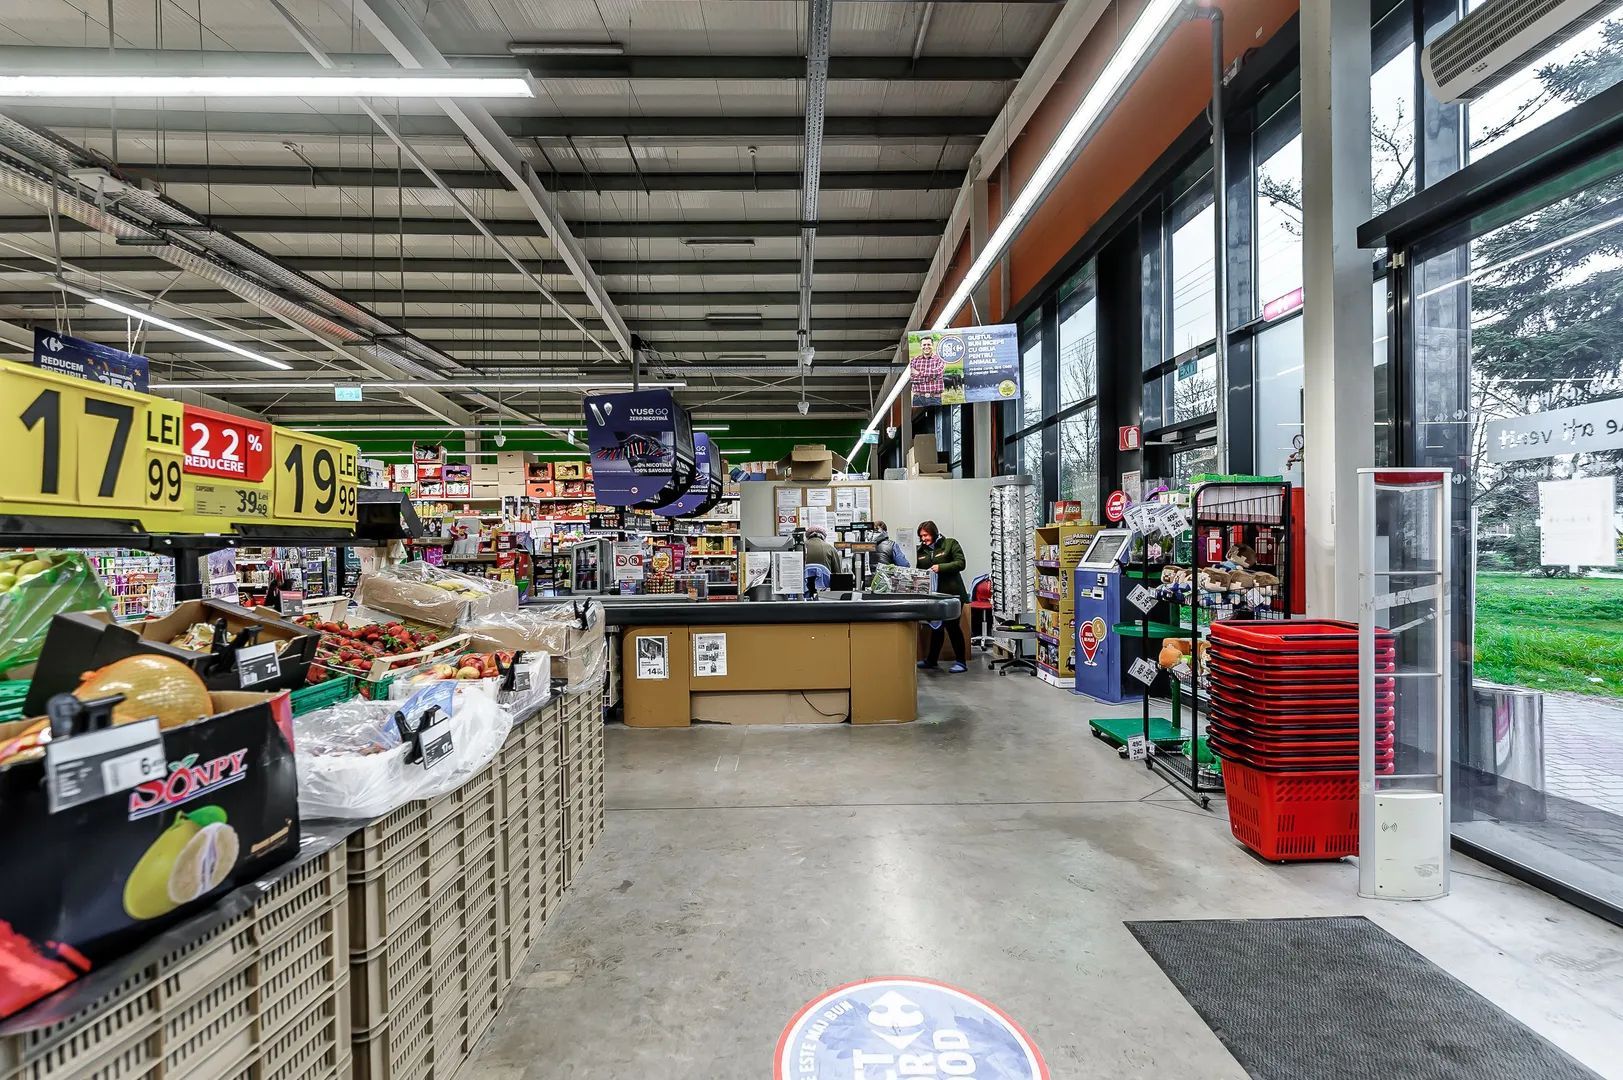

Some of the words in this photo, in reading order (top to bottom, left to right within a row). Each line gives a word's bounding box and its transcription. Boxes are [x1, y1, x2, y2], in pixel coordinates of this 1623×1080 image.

[41, 355, 84, 372] REDUCEM
[19, 389, 134, 498] 17
[147, 410, 180, 446] LEI
[184, 455, 245, 473] REDUCERE
[285, 443, 336, 514] 19
[340, 453, 356, 477] LEI
[148, 459, 182, 502] 99
[340, 485, 356, 516] 99
[829, 999, 856, 1022] BUN
[807, 1017, 830, 1042] MAI
[799, 1039, 818, 1073] ESTE
